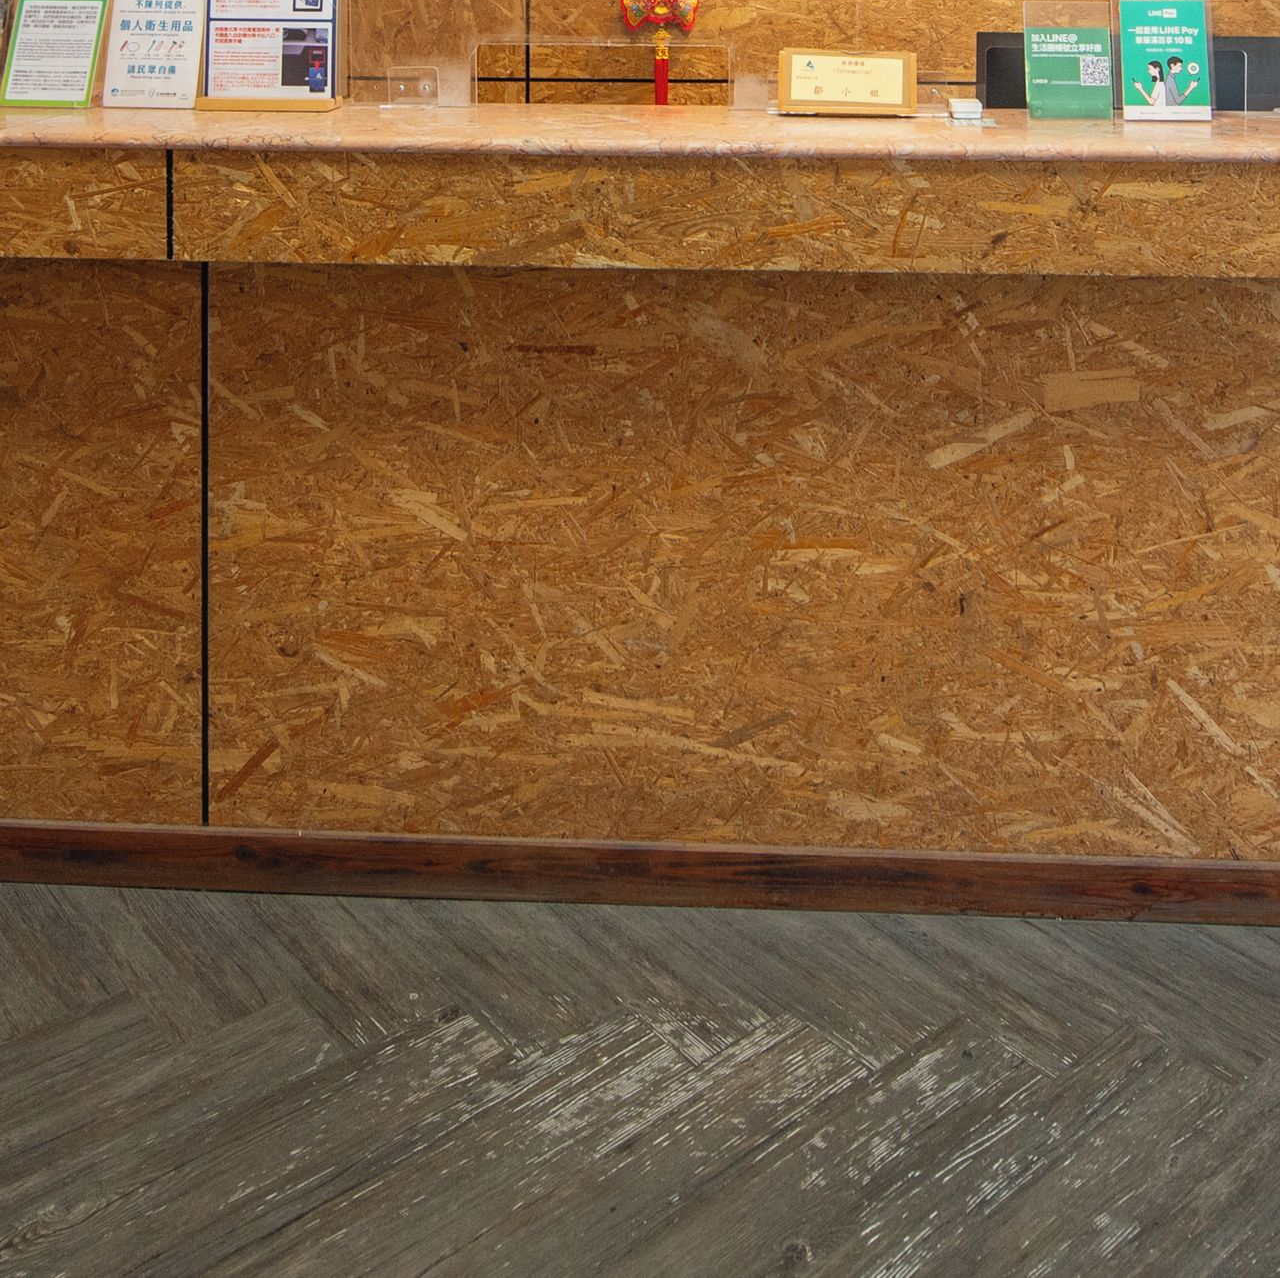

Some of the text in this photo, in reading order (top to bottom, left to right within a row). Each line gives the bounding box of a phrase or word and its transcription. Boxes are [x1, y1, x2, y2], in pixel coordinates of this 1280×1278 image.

[119, 19, 193, 32] 個人衛生用品
[1181, 26, 1199, 36] Pay
[1031, 34, 1078, 43] 加入LINE@
